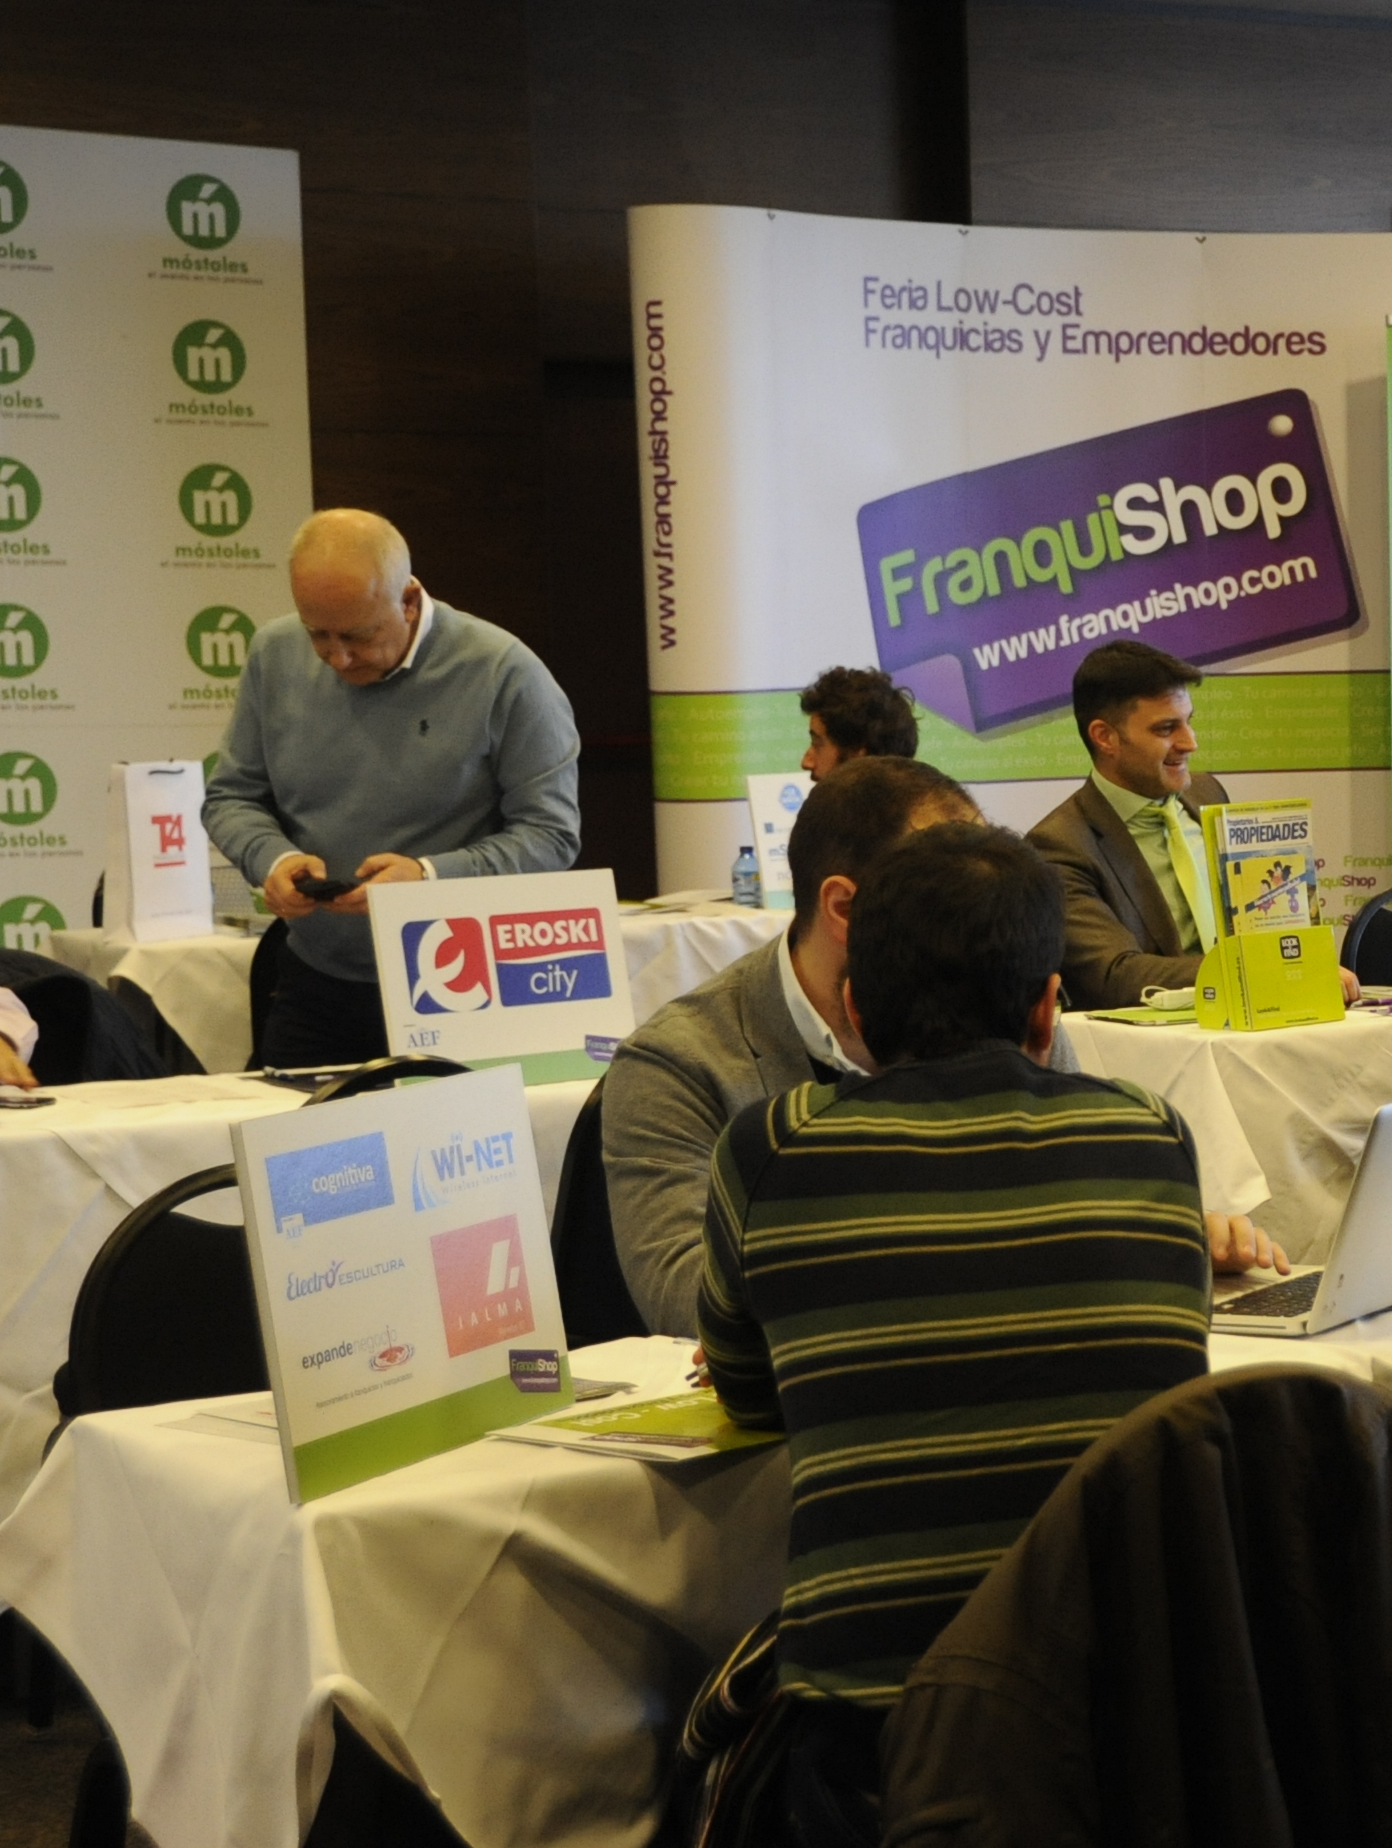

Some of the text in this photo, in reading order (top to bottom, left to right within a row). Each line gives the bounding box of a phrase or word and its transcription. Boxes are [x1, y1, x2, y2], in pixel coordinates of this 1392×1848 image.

[0, 242, 37, 260] oles
[162, 253, 248, 273] móstoles
[864, 276, 1084, 318] Feria Low-Cost
[864, 317, 1328, 362] Franquicias y Emprendedores
[0, 391, 43, 408] oles
[169, 399, 254, 417] móstoles
[644, 300, 677, 652] www.franquishop.com
[0, 538, 50, 555] toles
[175, 542, 260, 559] móstoles
[879, 462, 1309, 628] FranquiShop
[973, 554, 1318, 671] www.franquishop.com
[0, 683, 58, 700] stoles
[0, 829, 67, 847] óstoles
[1229, 821, 1308, 845] PROPIEDADES
[496, 918, 599, 950] EROSKI
[530, 964, 577, 998] city
[312, 1163, 375, 1195] cognitiva
